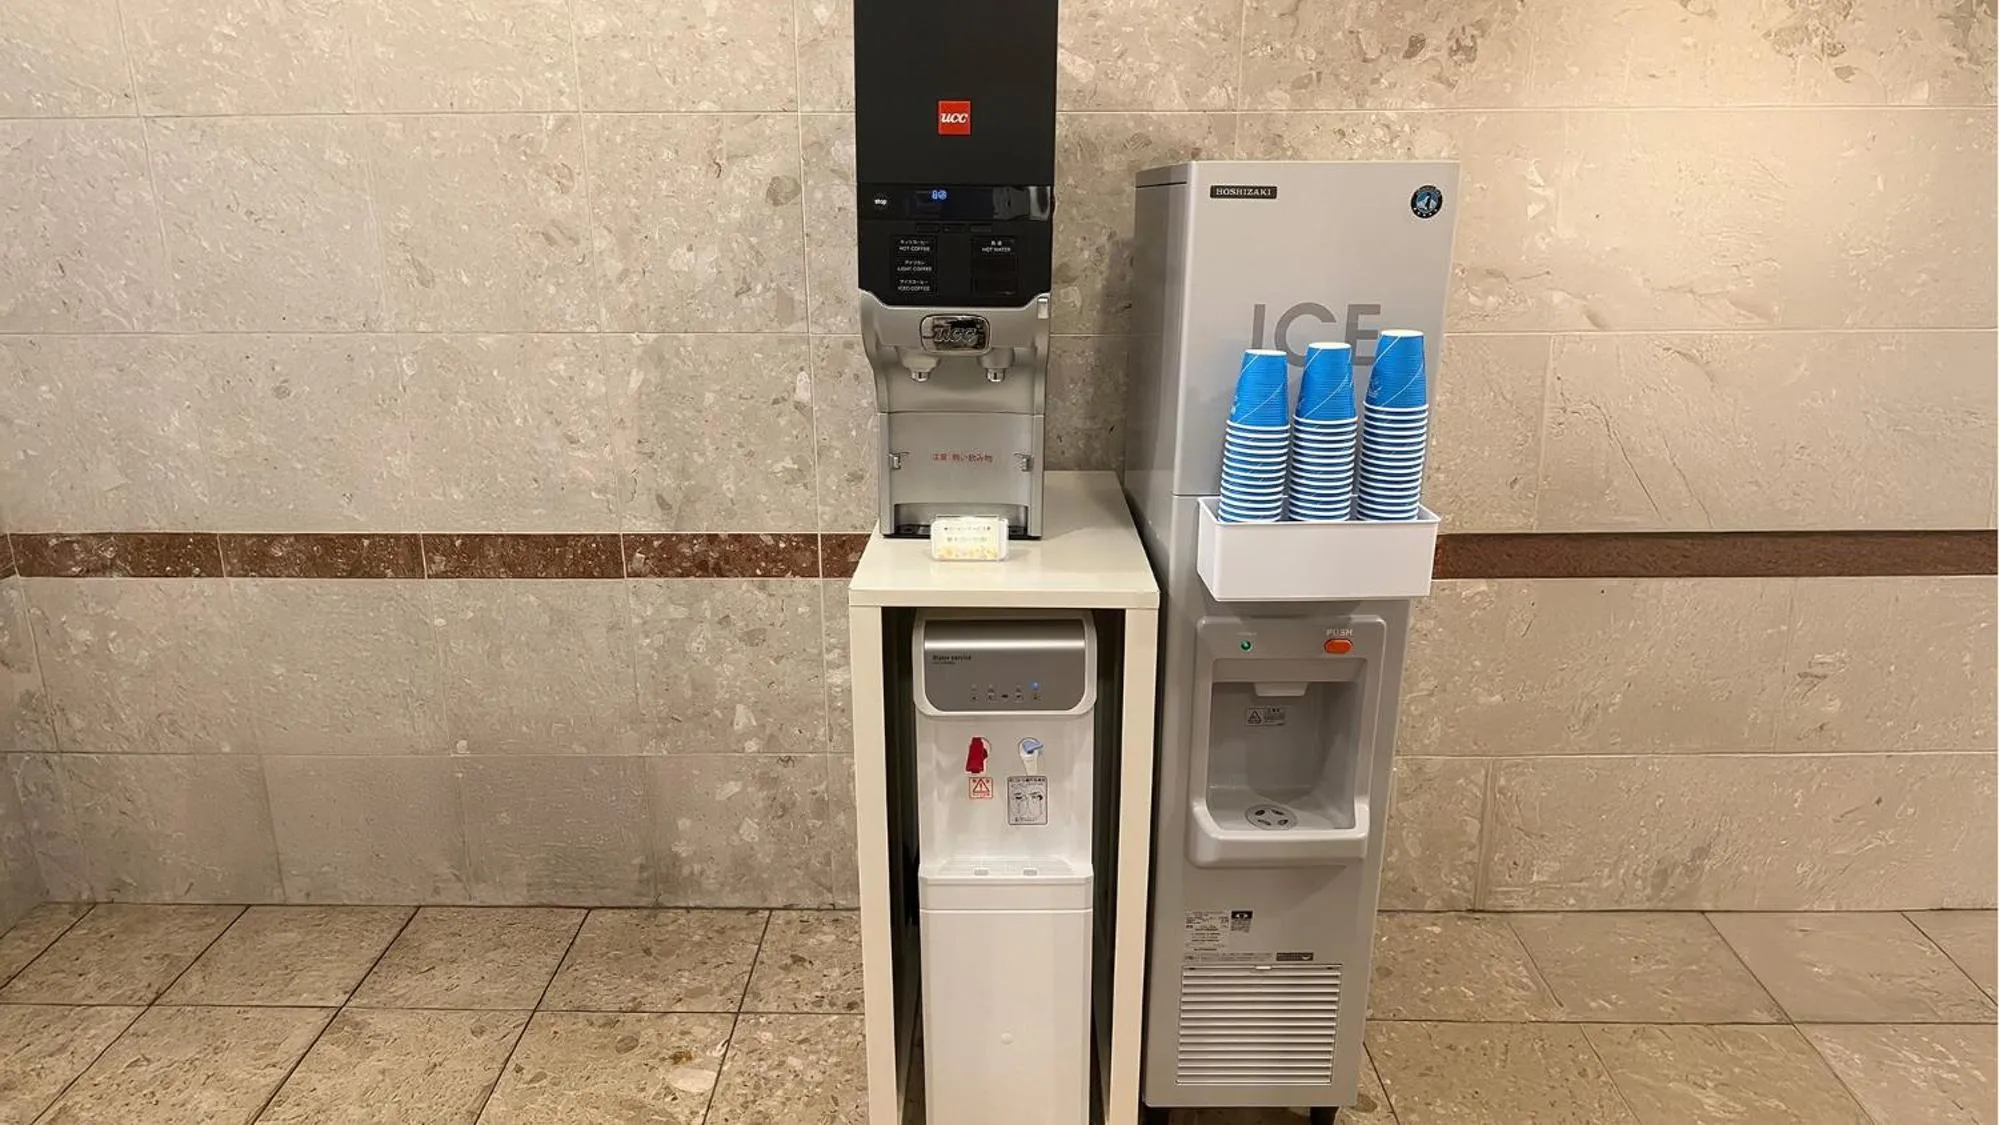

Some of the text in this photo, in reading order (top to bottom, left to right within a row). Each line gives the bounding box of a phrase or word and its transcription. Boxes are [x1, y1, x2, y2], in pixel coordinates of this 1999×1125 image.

[1215, 187, 1272, 197] HOSHIZAKI
[1252, 302, 1382, 367] ICE
[1325, 628, 1353, 637] PUSH
